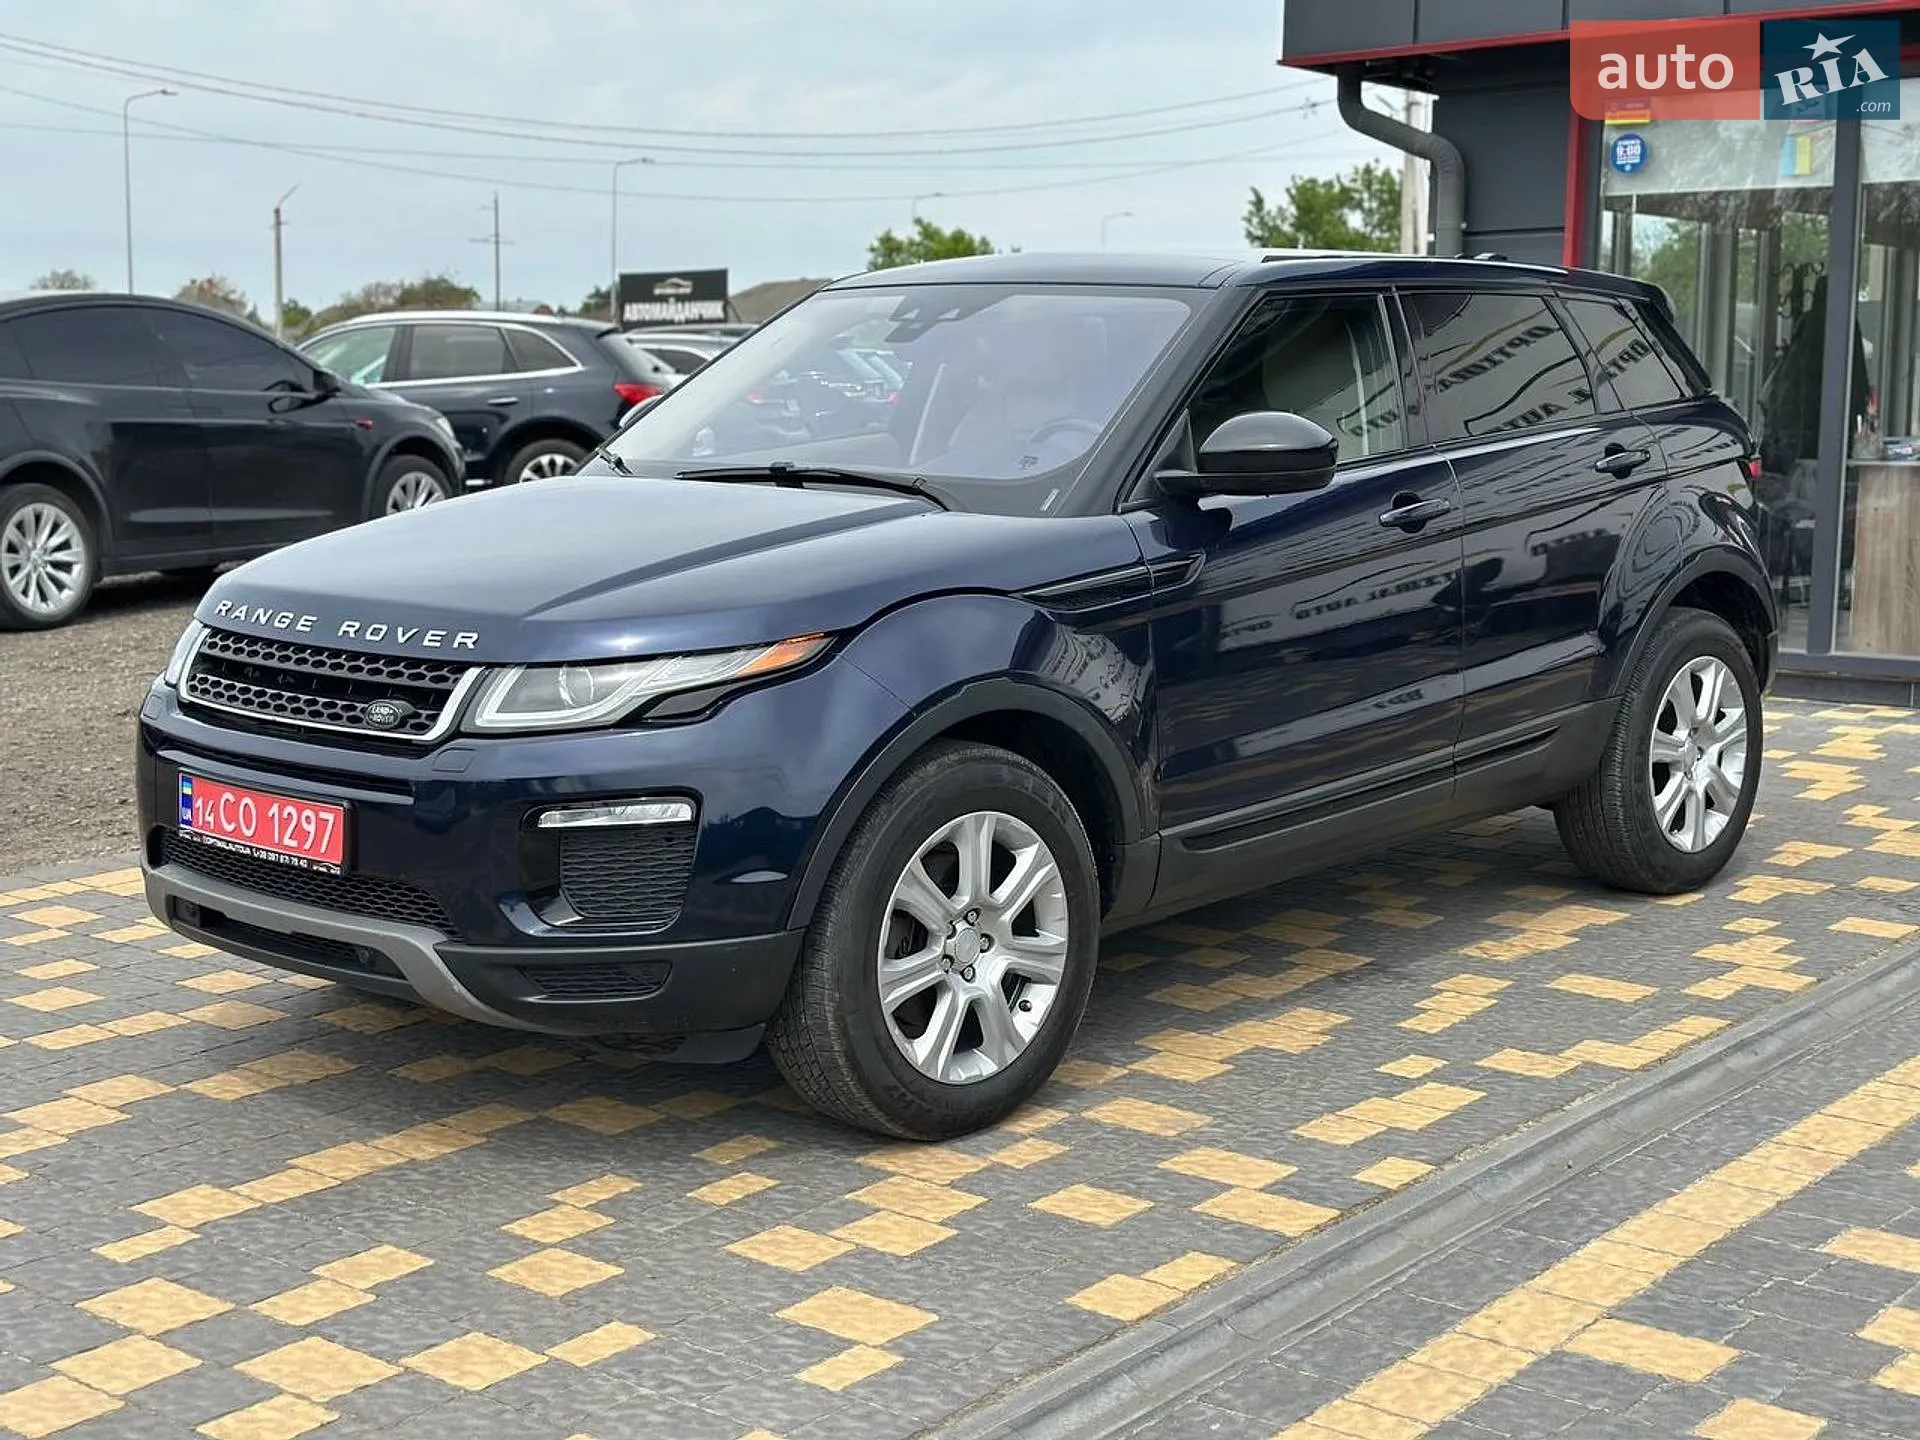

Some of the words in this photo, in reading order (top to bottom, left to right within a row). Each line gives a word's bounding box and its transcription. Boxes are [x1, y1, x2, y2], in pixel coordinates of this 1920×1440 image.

[624, 297, 724, 322] АВТОМАЙДАНЧИК
[215, 600, 317, 632] RANGE
[338, 620, 480, 649] ROVER
[268, 802, 336, 854] 1297
